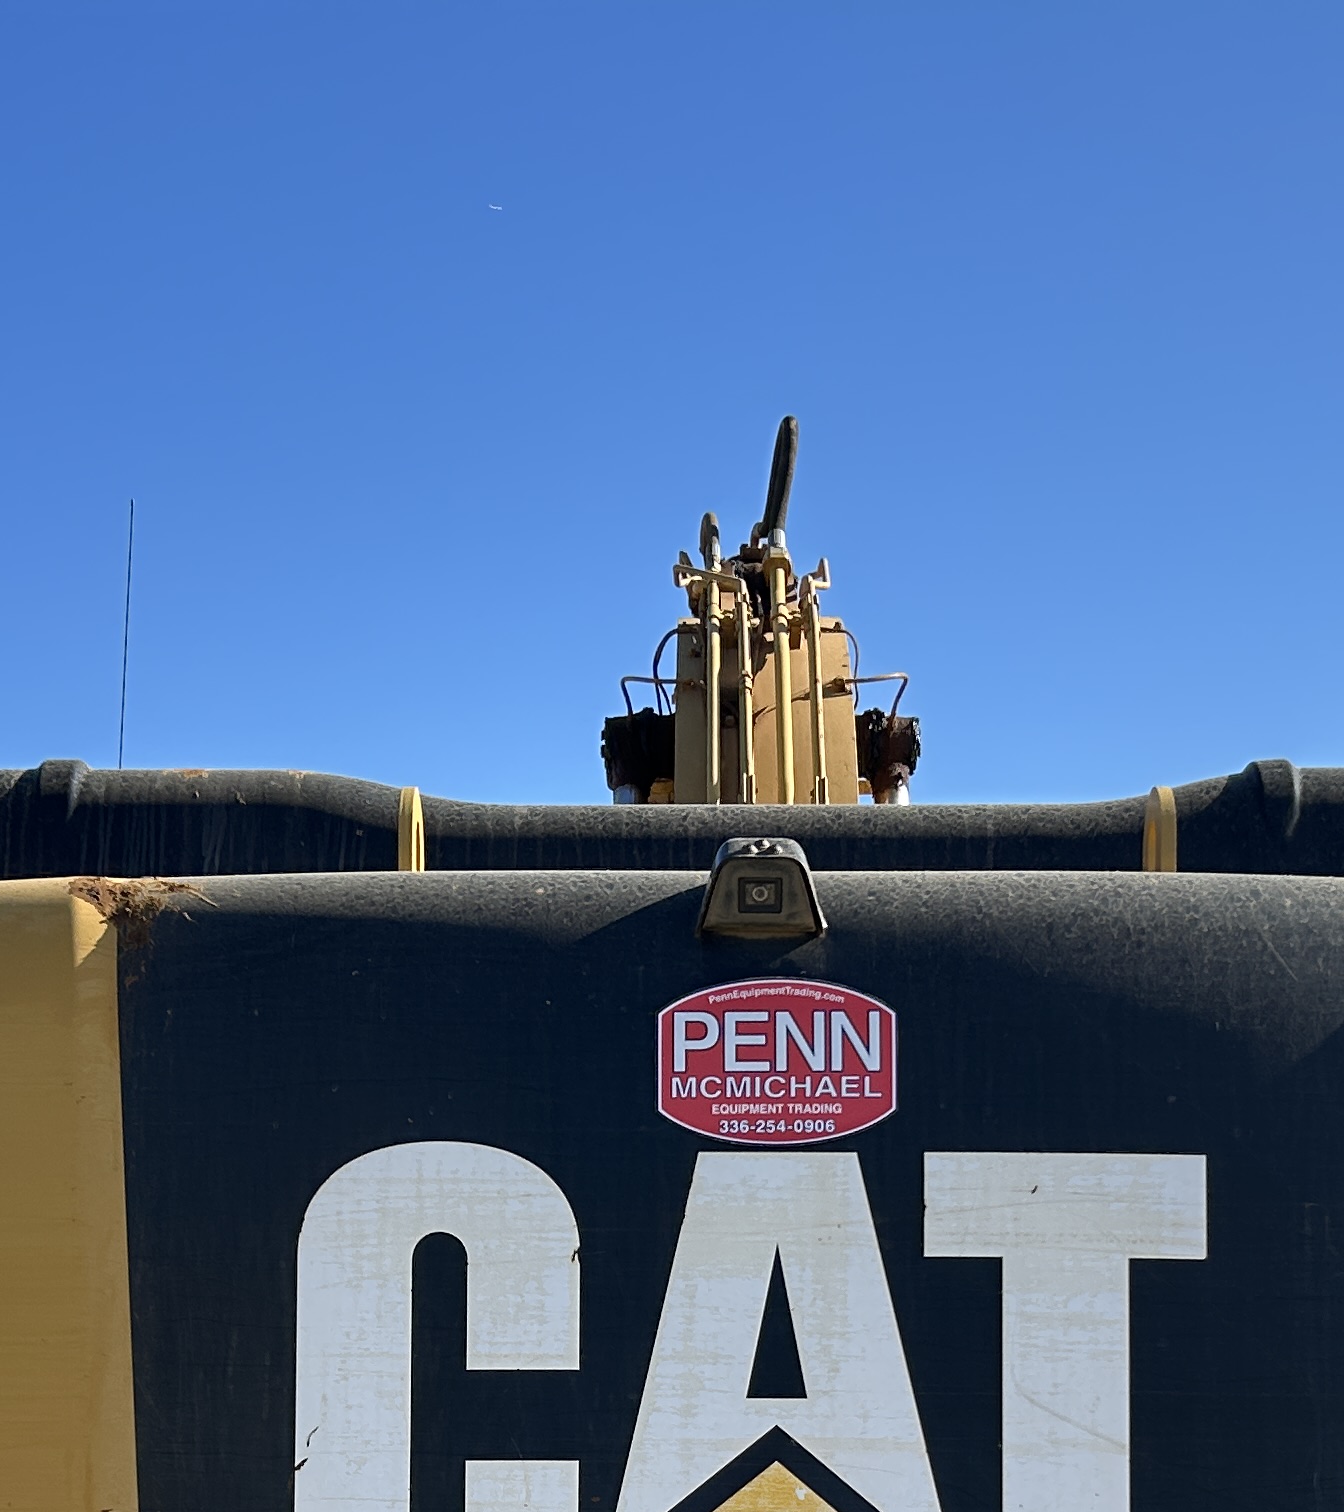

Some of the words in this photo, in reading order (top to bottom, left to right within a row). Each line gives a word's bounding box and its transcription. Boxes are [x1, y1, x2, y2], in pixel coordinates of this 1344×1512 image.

[708, 985, 845, 1004] PennEquipmentTrading.com
[673, 1011, 880, 1072] PENN
[671, 1076, 882, 1098] MCMICHAEL
[711, 1103, 783, 1115] EQUIPMENT
[787, 1103, 842, 1114] TRADING
[719, 1119, 835, 1133] 336-254-0906
